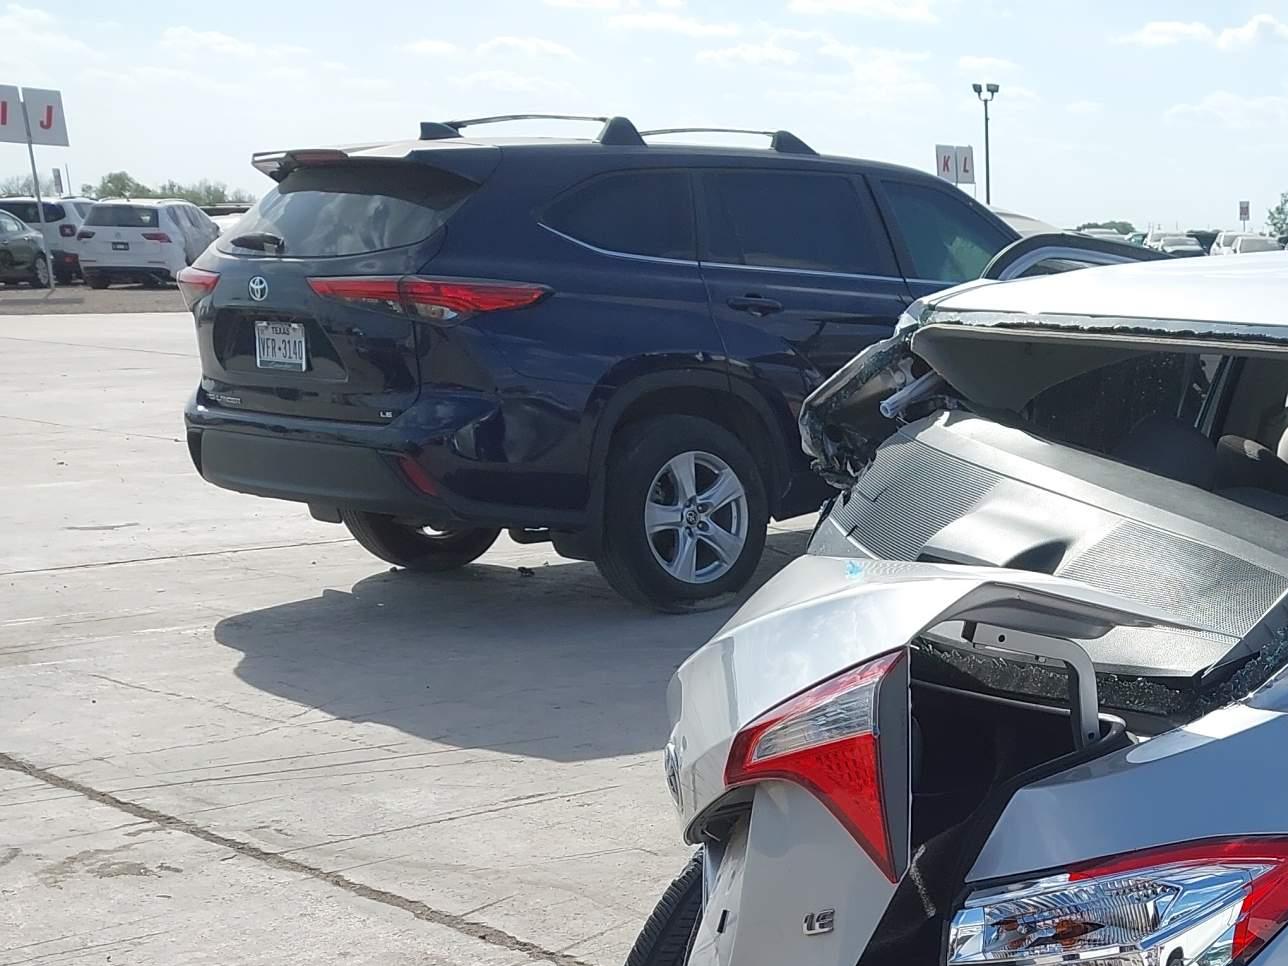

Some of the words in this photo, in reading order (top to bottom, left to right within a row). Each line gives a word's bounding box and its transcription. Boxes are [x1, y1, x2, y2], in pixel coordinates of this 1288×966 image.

[0, 101, 8, 125] I
[39, 105, 54, 130] J
[942, 155, 951, 173] K
[962, 156, 970, 173] L
[271, 326, 290, 335] TEXAS
[802, 907, 835, 936] LE
